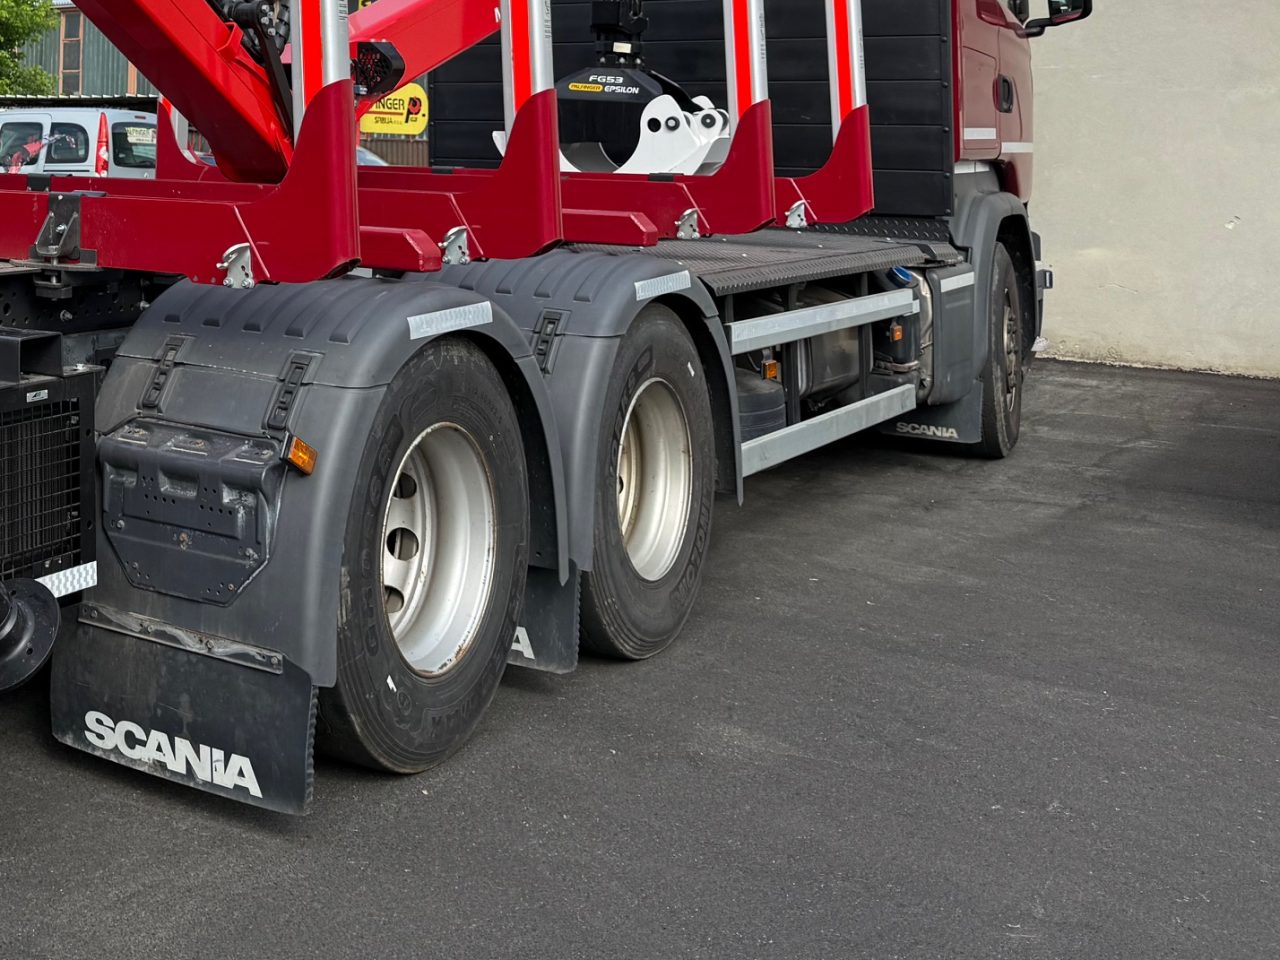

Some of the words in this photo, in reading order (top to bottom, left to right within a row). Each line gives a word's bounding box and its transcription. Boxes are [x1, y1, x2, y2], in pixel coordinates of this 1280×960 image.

[588, 74, 624, 85] FG53
[604, 85, 640, 95] EPSILON
[895, 422, 959, 439] SCANIA
[84, 710, 263, 799] SCANIA
